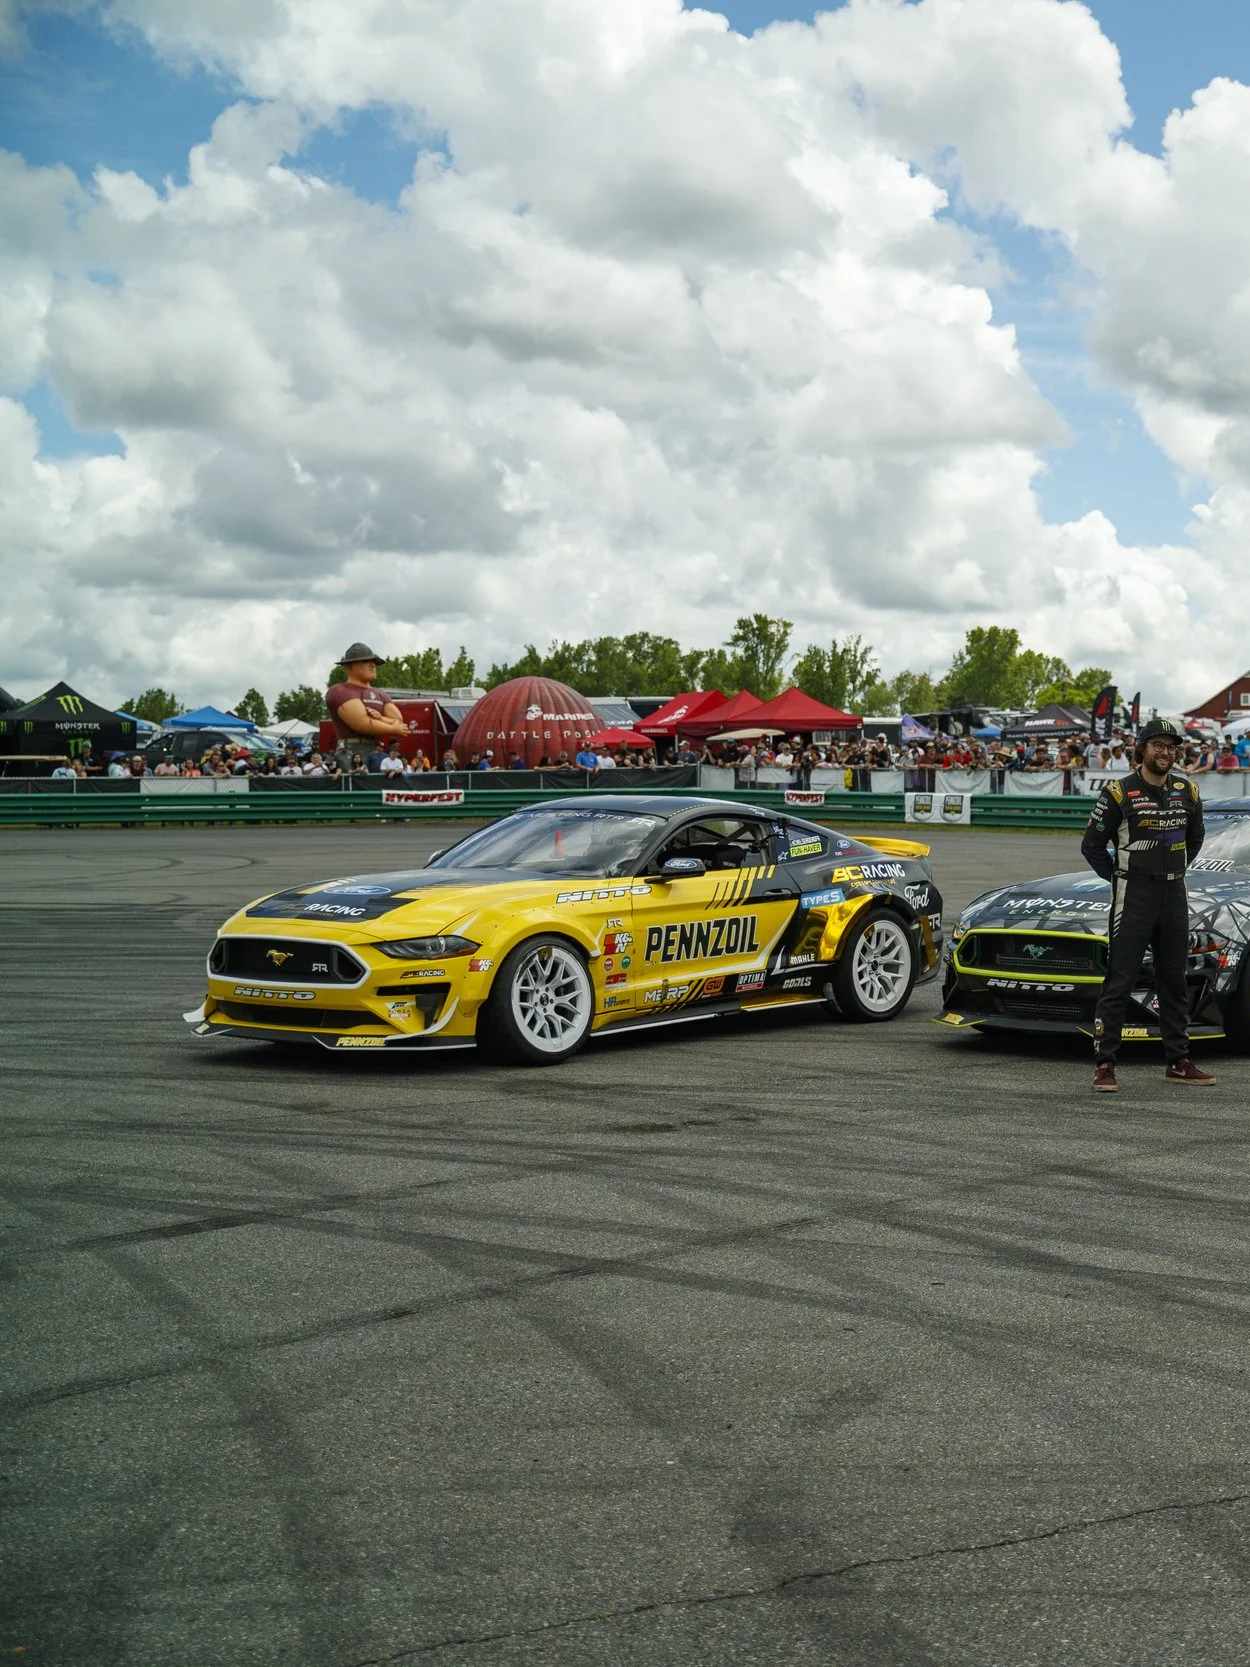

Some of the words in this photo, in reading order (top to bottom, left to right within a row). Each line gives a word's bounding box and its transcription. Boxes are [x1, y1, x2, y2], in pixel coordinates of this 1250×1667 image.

[55, 722, 101, 730] MONSTER
[1024, 719, 1057, 727] HAWK
[486, 731, 552, 740] BATTLE
[385, 792, 463, 803] HYPERFEST
[1159, 818, 1187, 827] RACING
[791, 844, 821, 856] FUN-HAVER
[832, 866, 864, 883] BC
[861, 864, 906, 879] RACING
[556, 885, 652, 904] NITTO
[904, 884, 930, 910] Ford
[304, 903, 366, 916] RACING
[1008, 909, 1092, 918] ENERGY
[644, 915, 760, 963] PENNZOIL
[311, 963, 328, 972] RTR
[418, 969, 446, 977] RACING
[739, 973, 765, 985] OPTIMA
[987, 978, 1075, 991] NITTO
[234, 986, 316, 1000] NITTO
[336, 1037, 386, 1047] PENNZOIL
